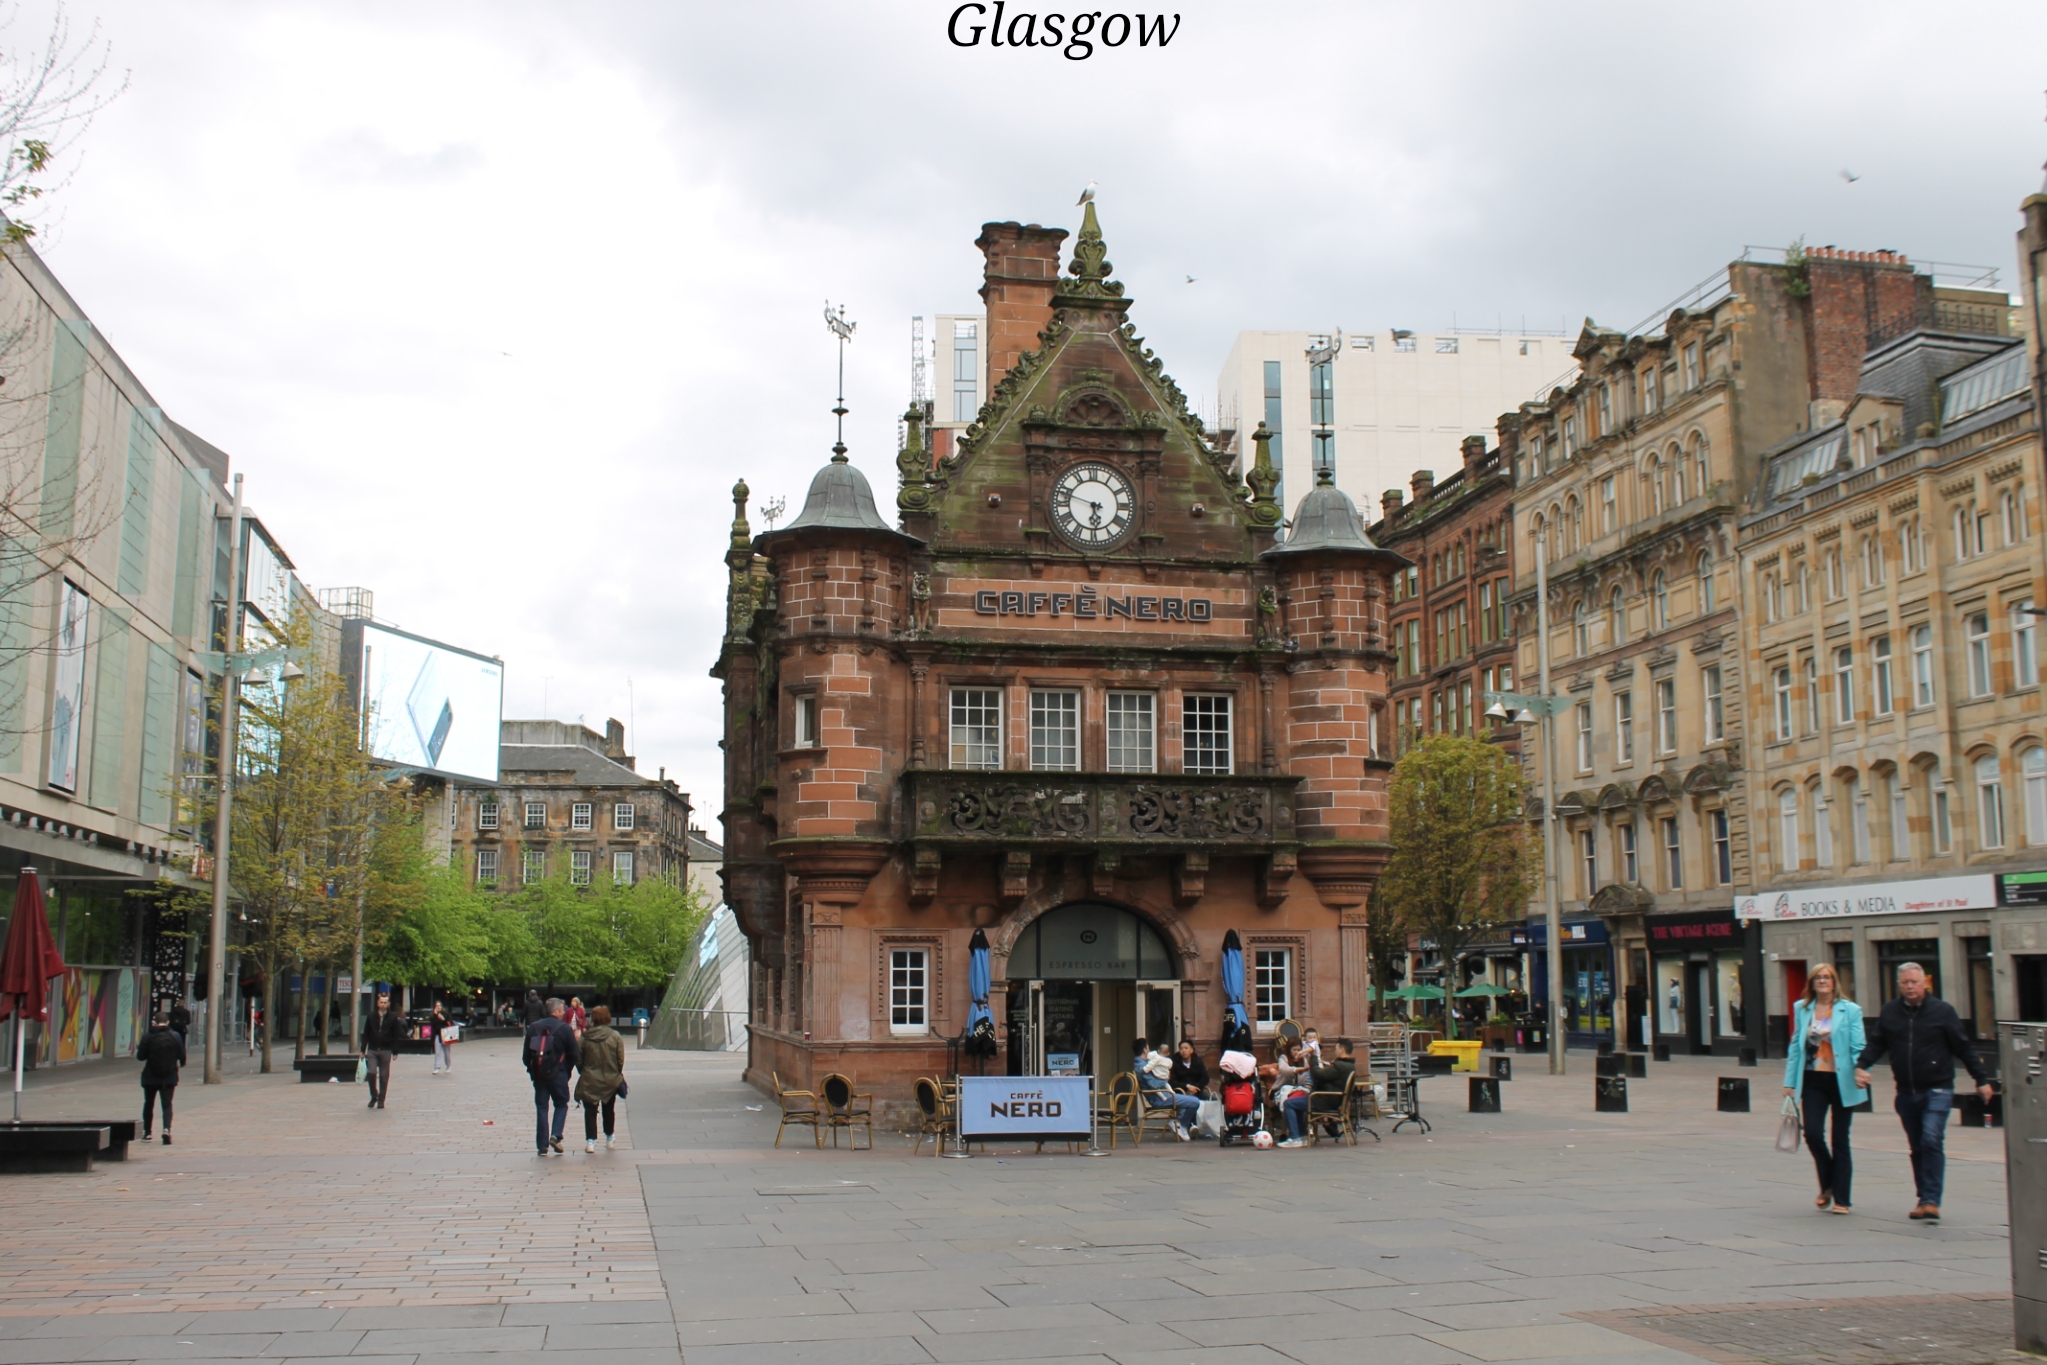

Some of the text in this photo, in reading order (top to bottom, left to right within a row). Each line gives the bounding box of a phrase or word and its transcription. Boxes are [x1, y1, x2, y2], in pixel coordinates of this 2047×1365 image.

[975, 584, 1212, 622] CAFFÈ NERO
[1801, 900, 1838, 917] BOOKS
[1843, 900, 1852, 914] &
[1857, 897, 1896, 913] MEDIA
[1905, 901, 1936, 911] Daughters
[1937, 899, 1945, 908] of
[1955, 898, 1968, 907] Paul
[1652, 922, 1732, 939] THE VINTAGE SCENE
[1010, 1090, 1043, 1100] CAFFÈ
[990, 1102, 1062, 1118] NERO
